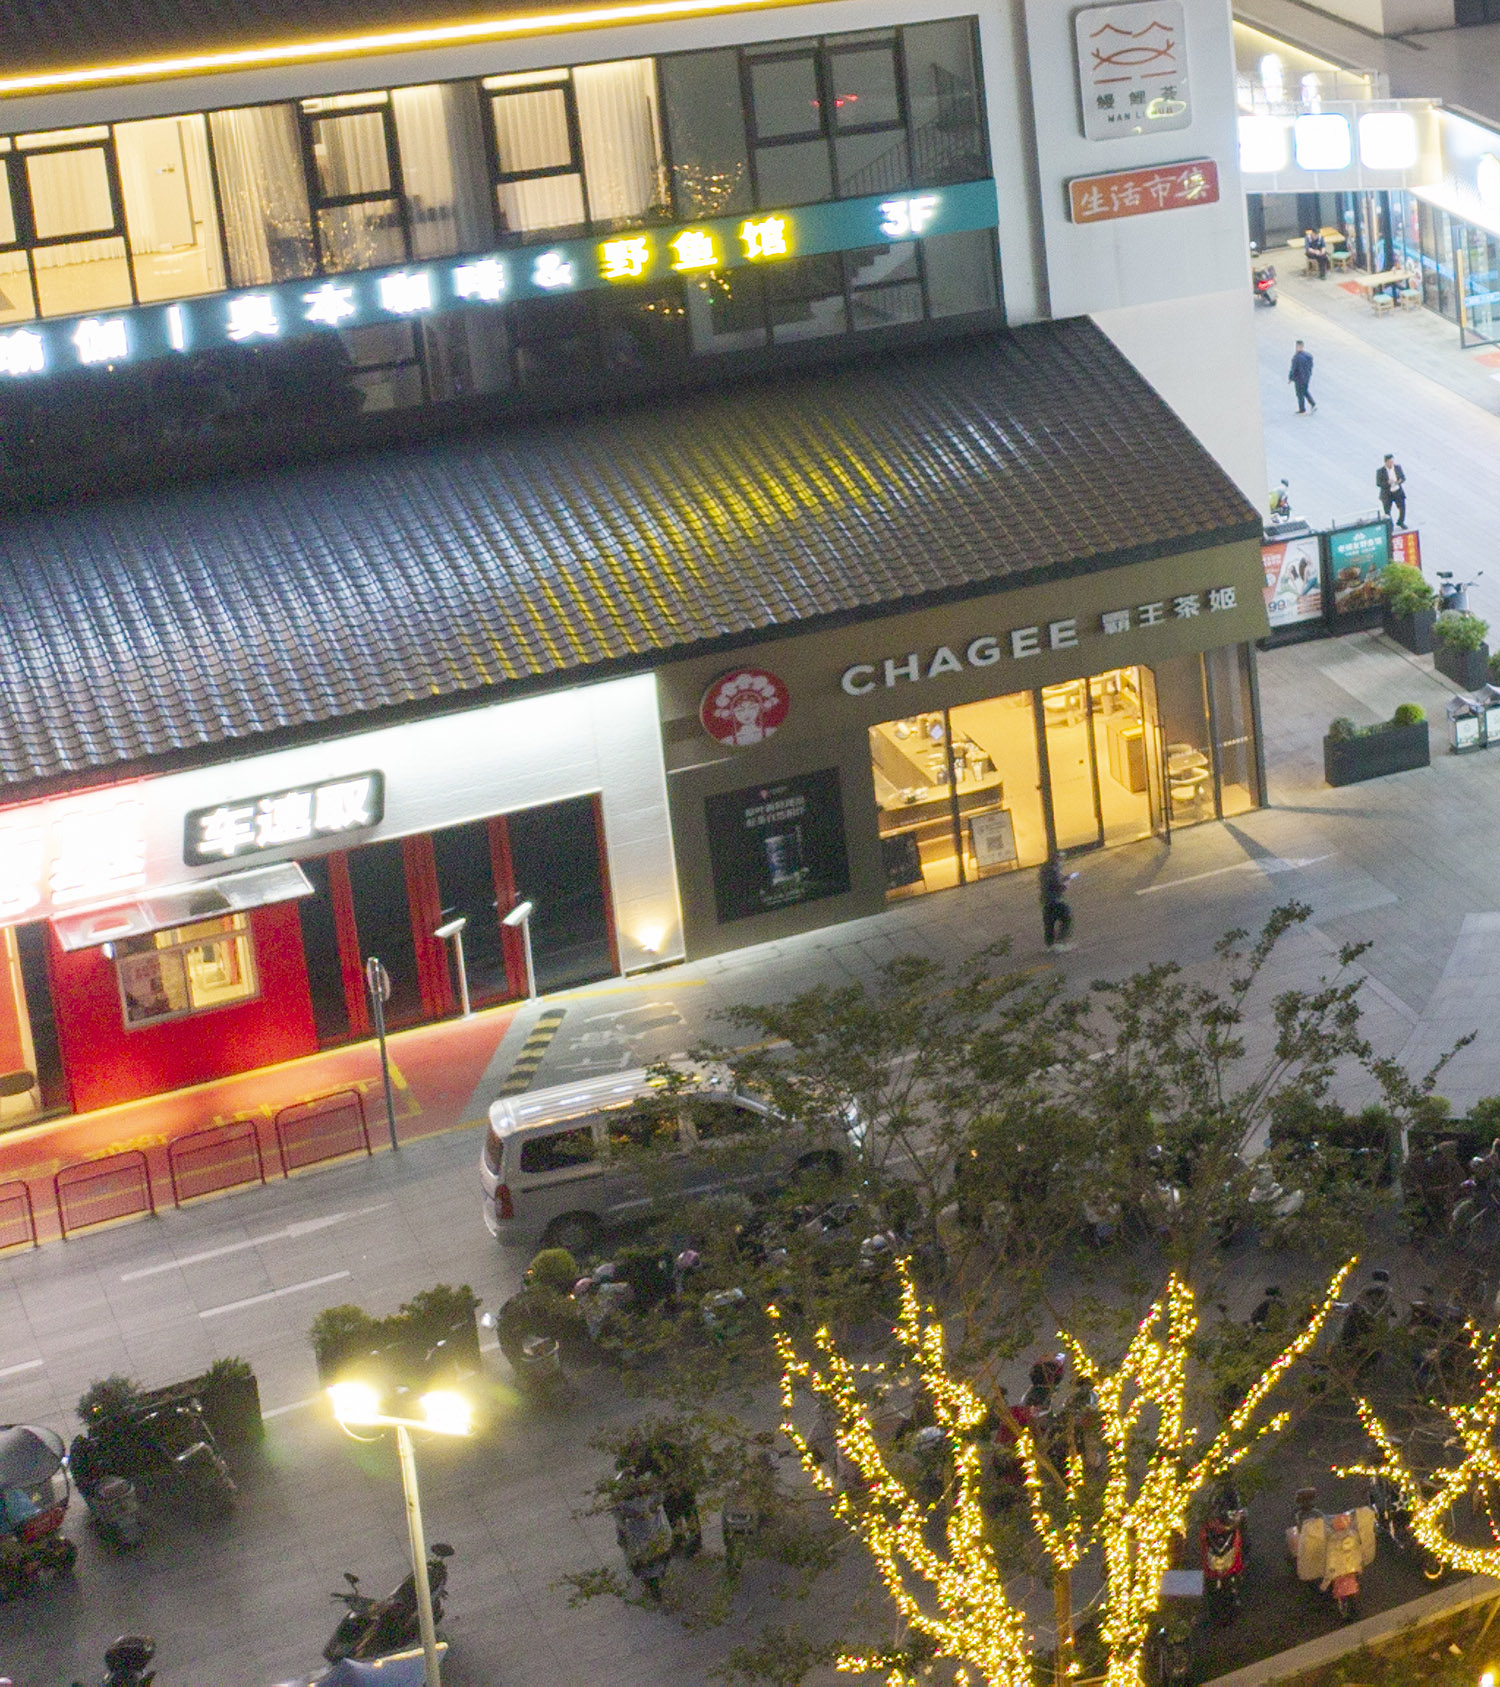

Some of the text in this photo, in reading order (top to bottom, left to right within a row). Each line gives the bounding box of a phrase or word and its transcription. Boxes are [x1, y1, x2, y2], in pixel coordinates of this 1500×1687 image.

[1080, 167, 1210, 216] 生活市集
[880, 197, 937, 236] 3F
[841, 586, 1238, 696] CHAGEE 霸王茶姬
